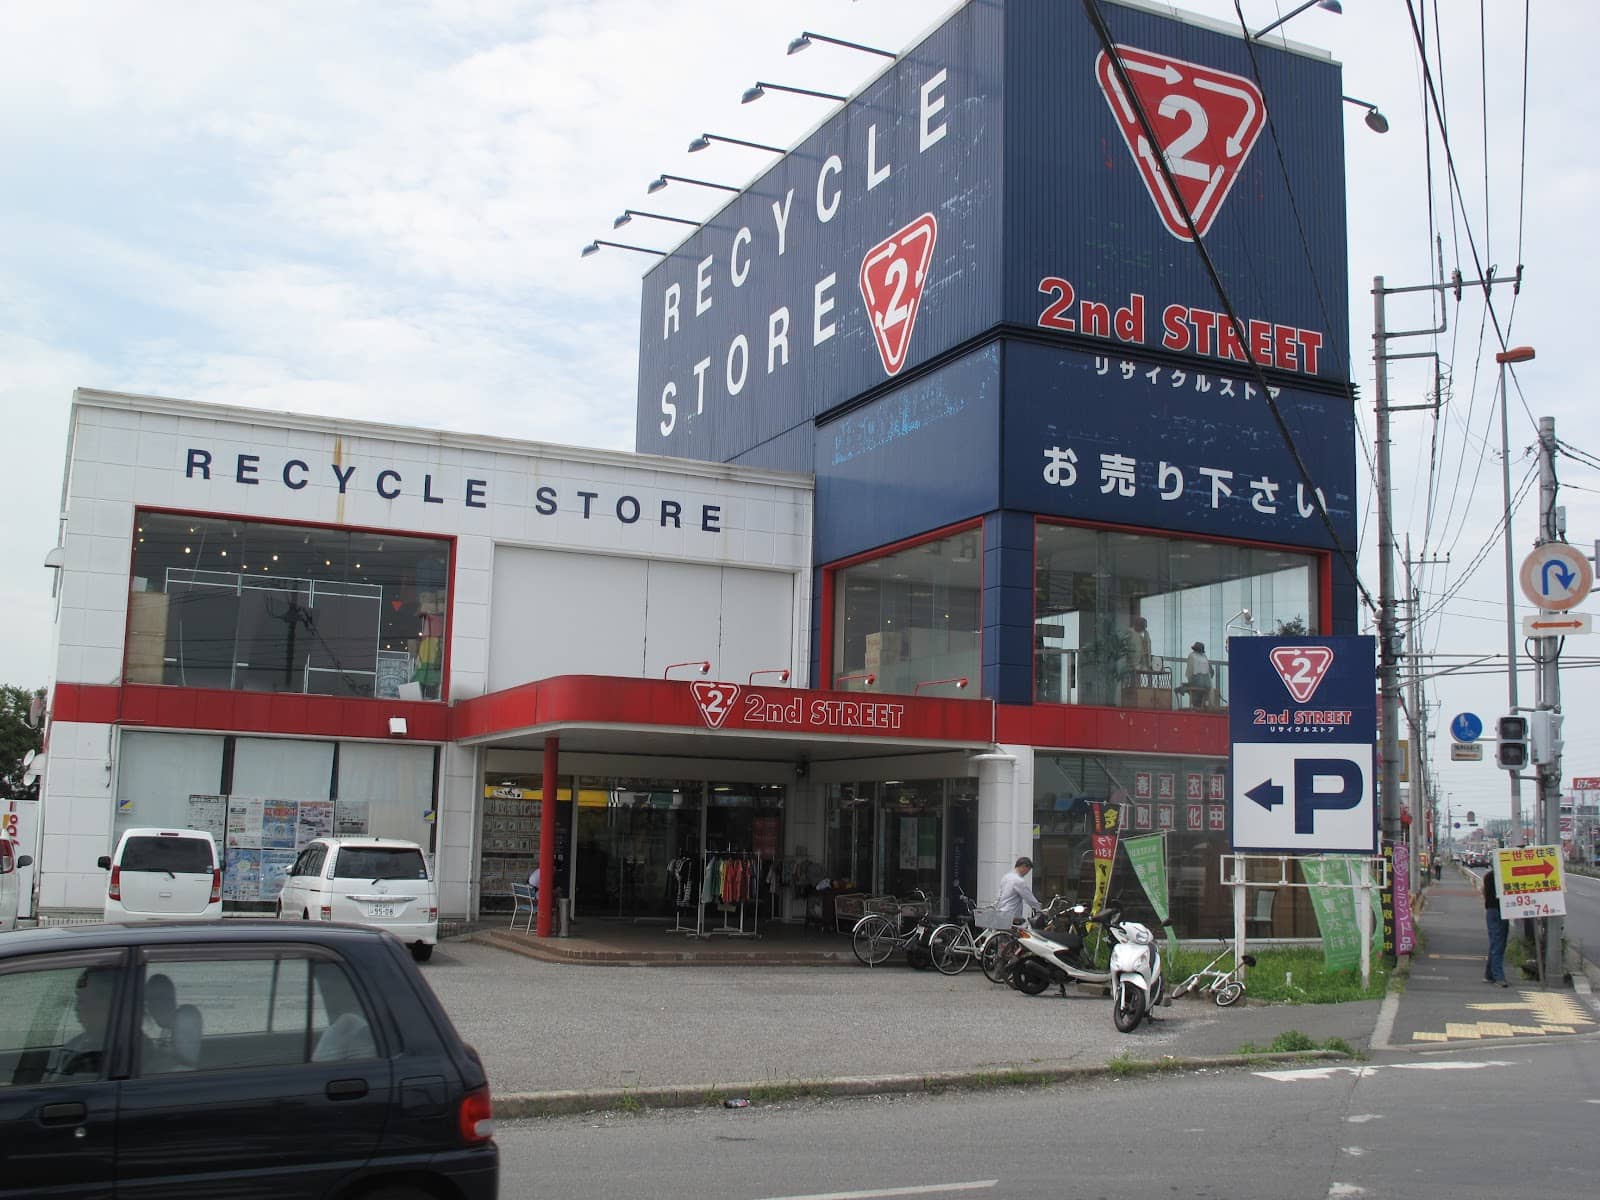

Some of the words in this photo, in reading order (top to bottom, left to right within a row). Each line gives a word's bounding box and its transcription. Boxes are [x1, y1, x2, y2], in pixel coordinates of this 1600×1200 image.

[1157, 93, 1211, 183] 2
[664, 68, 949, 341] RECYCLE
[884, 257, 909, 328] 2
[1037, 276, 1145, 344] 2nd
[1161, 305, 1324, 376] STREET
[660, 272, 837, 437] STORE
[1094, 356, 1281, 402] リサイクルストア
[186, 448, 488, 509] RECYCLE
[535, 486, 723, 533] STORE
[1042, 445, 1328, 520] お売り下さい
[707, 690, 723, 712] 2
[1291, 657, 1312, 683] 2
[744, 694, 803, 723] 2nd
[810, 700, 904, 728] STREET
[1253, 709, 1289, 725] 2nd
[1293, 710, 1352, 725] STREET
[1294, 758, 1364, 834] P
[1500, 847, 1555, 861] 二世帯住宅
